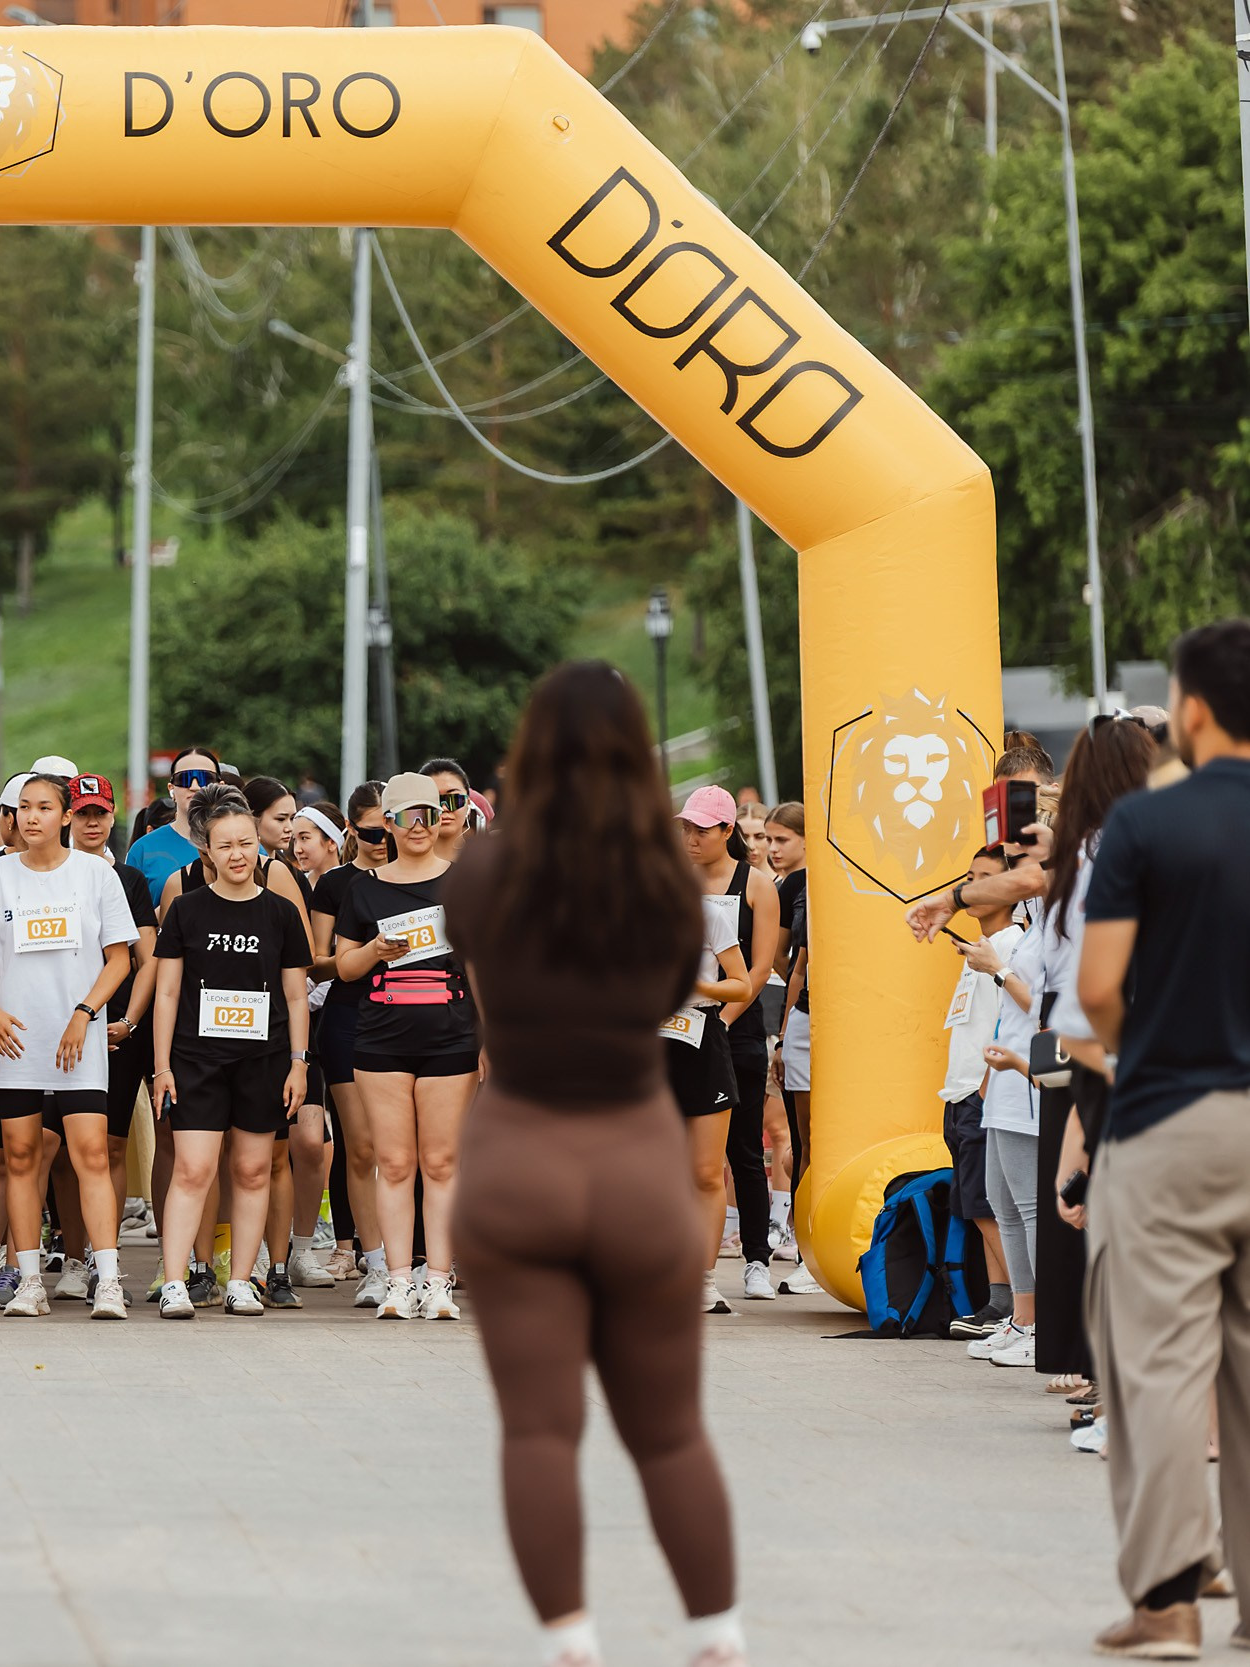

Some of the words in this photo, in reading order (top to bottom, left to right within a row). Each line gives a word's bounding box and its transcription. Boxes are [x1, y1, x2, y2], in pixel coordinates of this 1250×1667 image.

[124, 71, 401, 138] D'ORO
[546, 165, 865, 459] D'ORO
[18, 908, 42, 917] LEONE
[31, 920, 63, 937] 037
[384, 920, 406, 931] LEONE
[408, 928, 432, 947] 78
[206, 995, 230, 1003] LEONE
[218, 1008, 250, 1024] 022
[663, 1016, 687, 1031] 28
